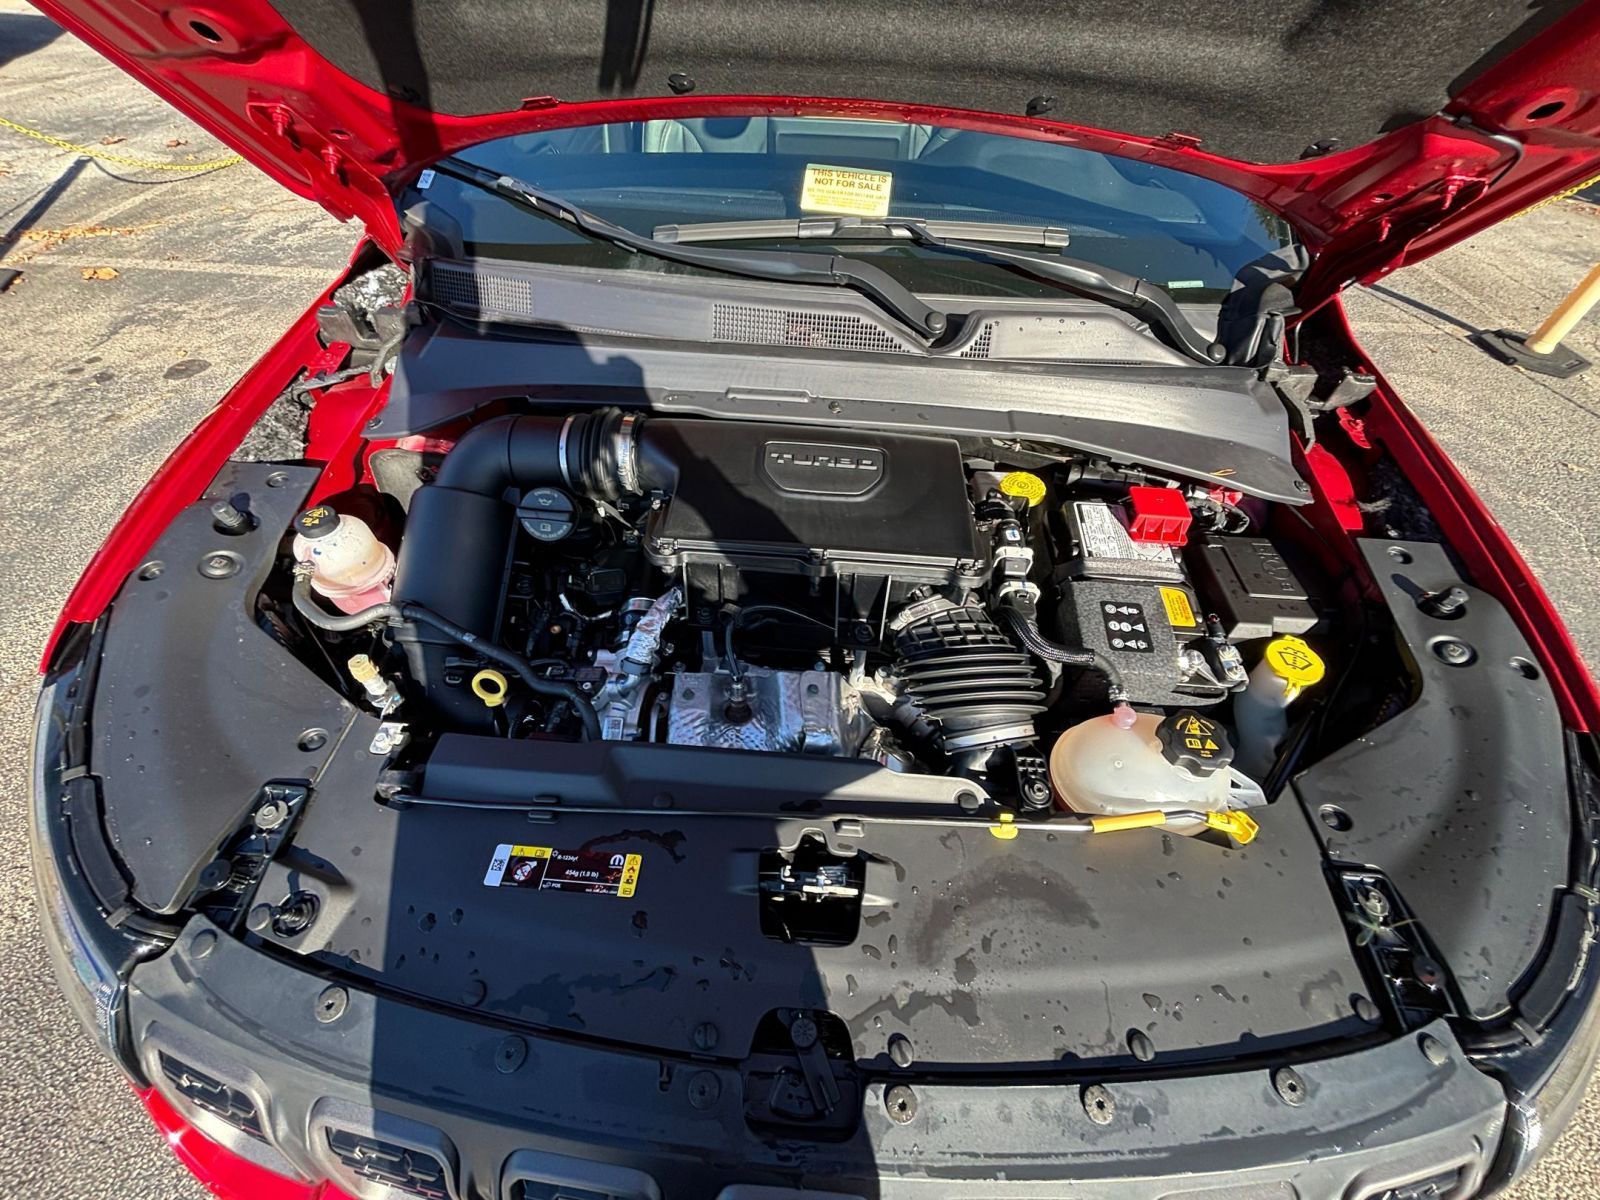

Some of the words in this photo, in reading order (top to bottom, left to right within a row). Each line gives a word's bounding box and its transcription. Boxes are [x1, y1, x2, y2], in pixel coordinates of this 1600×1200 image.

[813, 168, 833, 177] THIS
[836, 171, 876, 182] VEHICLE
[878, 175, 887, 183] IS
[814, 177, 834, 186] NOT
[836, 179, 856, 188] FOR
[857, 181, 883, 192] SALE
[770, 453, 878, 470] TURBO
